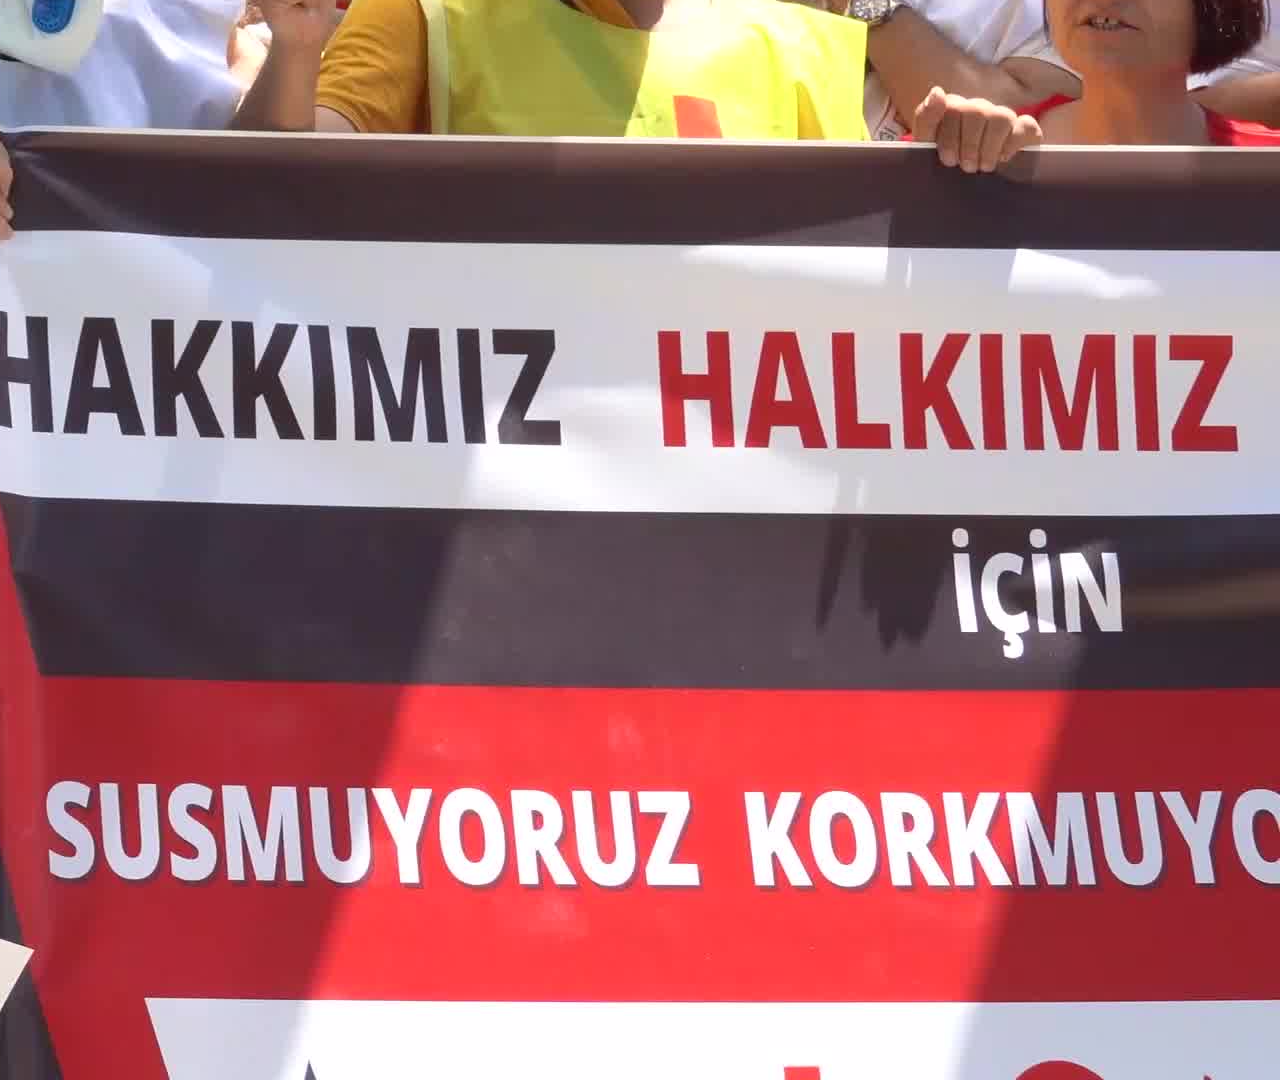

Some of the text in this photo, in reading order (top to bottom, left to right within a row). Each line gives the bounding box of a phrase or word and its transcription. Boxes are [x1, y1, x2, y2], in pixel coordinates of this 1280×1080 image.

[657, 330, 1239, 453] HALKIMIZ
[951, 528, 1124, 659] İÇİN
[45, 780, 700, 888] SUSMUYORUZ
